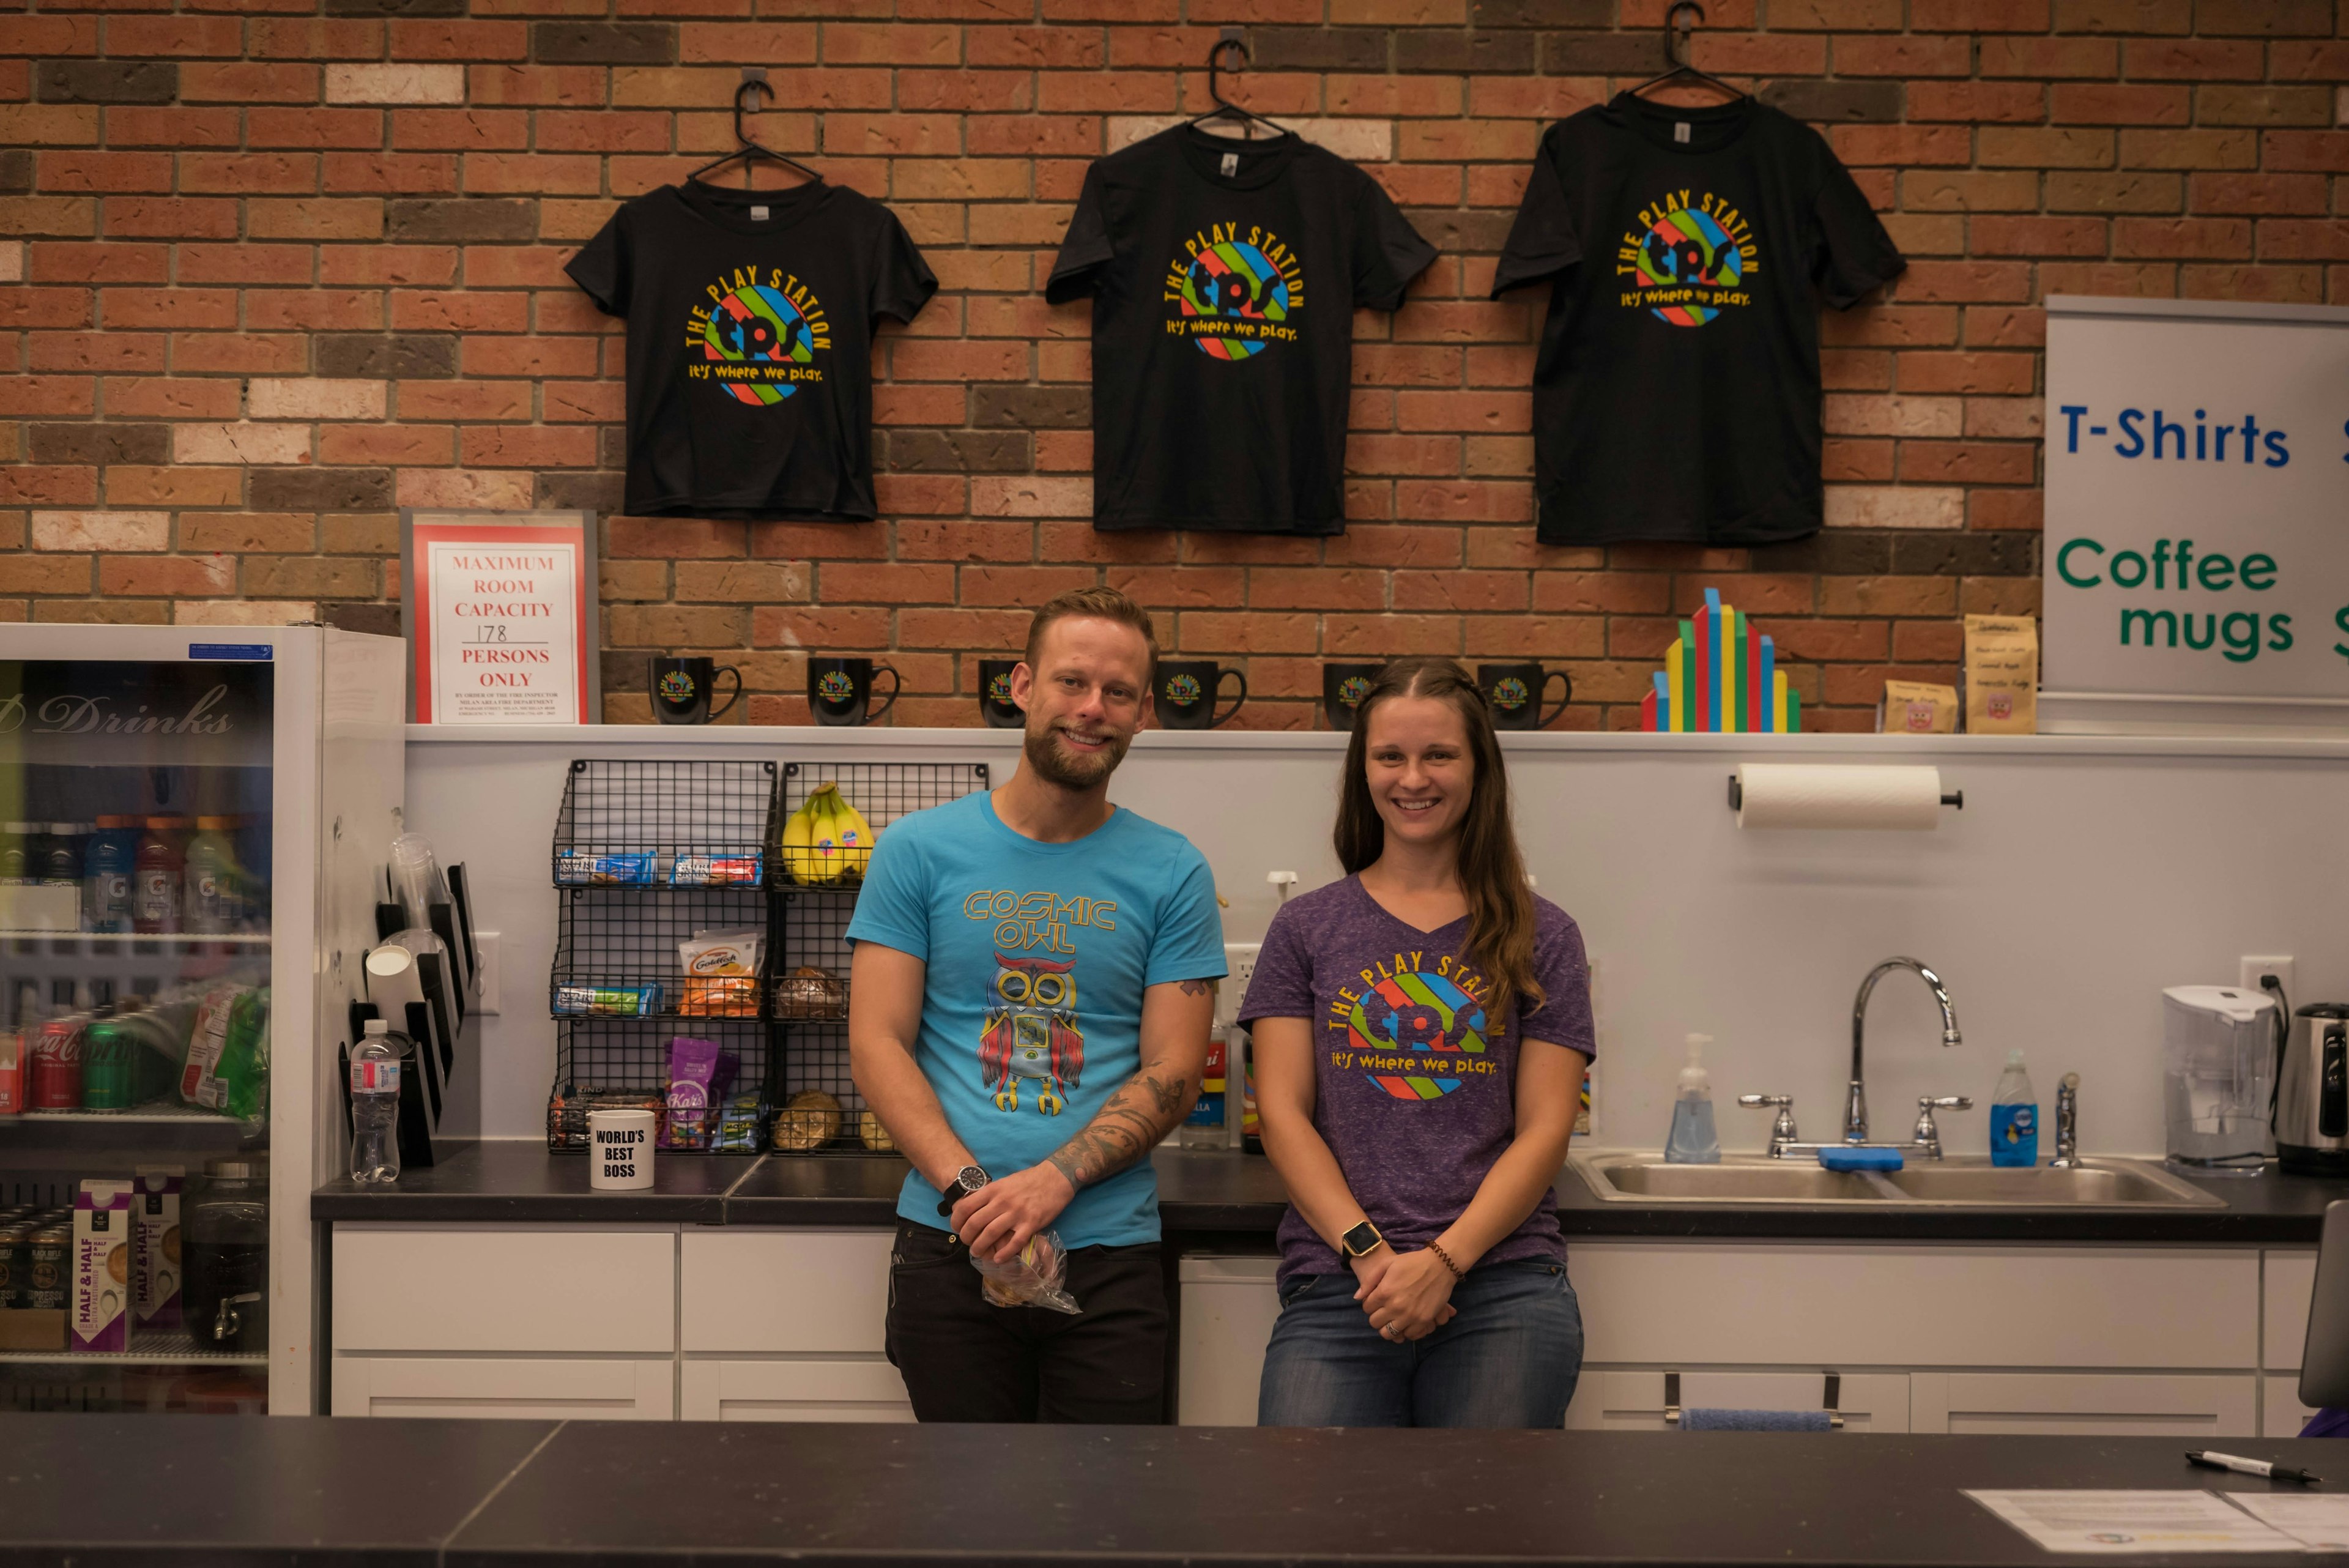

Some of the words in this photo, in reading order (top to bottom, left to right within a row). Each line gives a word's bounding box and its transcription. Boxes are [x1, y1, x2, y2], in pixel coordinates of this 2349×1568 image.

[1617, 232, 1643, 275] THE
[1638, 189, 1690, 228] PLAY
[1701, 192, 1759, 273] STATION
[1165, 259, 1189, 302] THE
[1185, 222, 1236, 258] PLAY
[1248, 226, 1304, 307] STATION
[686, 305, 711, 347] THE
[706, 265, 757, 303] PLAY
[770, 269, 831, 349] STATION
[1646, 289, 1693, 303] where
[1713, 291, 1750, 305] play.
[1167, 320, 1186, 335] it's
[1190, 319, 1230, 334] where
[1234, 322, 1255, 335] we
[1260, 324, 1297, 341] play.
[689, 365, 711, 379] it's
[714, 365, 759, 379] where
[764, 366, 786, 380] we
[790, 368, 823, 382] play.
[2060, 404, 2290, 468] T-Shirts
[453, 557, 554, 570] MAXIMUM
[2057, 537, 2278, 592] Coffee
[474, 580, 534, 593] ROOM
[455, 603, 554, 617] CAPACITY
[478, 625, 507, 642] 178
[2120, 608, 2294, 663] mugs
[462, 650, 550, 663] PERSONS
[480, 673, 532, 686] ONLY
[32, 684, 234, 734] Drinks
[149, 875, 166, 896] G
[964, 890, 1117, 931] COSMIC
[993, 920, 1075, 954] OWL
[696, 954, 737, 970] Goldfish
[1329, 986, 1361, 1030] THE
[1359, 951, 1423, 987] PLAY
[1332, 1052, 1354, 1069] it's
[1359, 1055, 1416, 1069] where
[1422, 1057, 1449, 1072] we
[1456, 1058, 1497, 1075] play.
[596, 1130, 644, 1144] WORLD'S
[605, 1148, 634, 1160] BEST
[604, 1164, 635, 1178] BOSS
[81, 1238, 92, 1273] HALF
[80, 1276, 91, 1286] &
[138, 1271, 148, 1302] HALF
[80, 1288, 91, 1323] HALF
